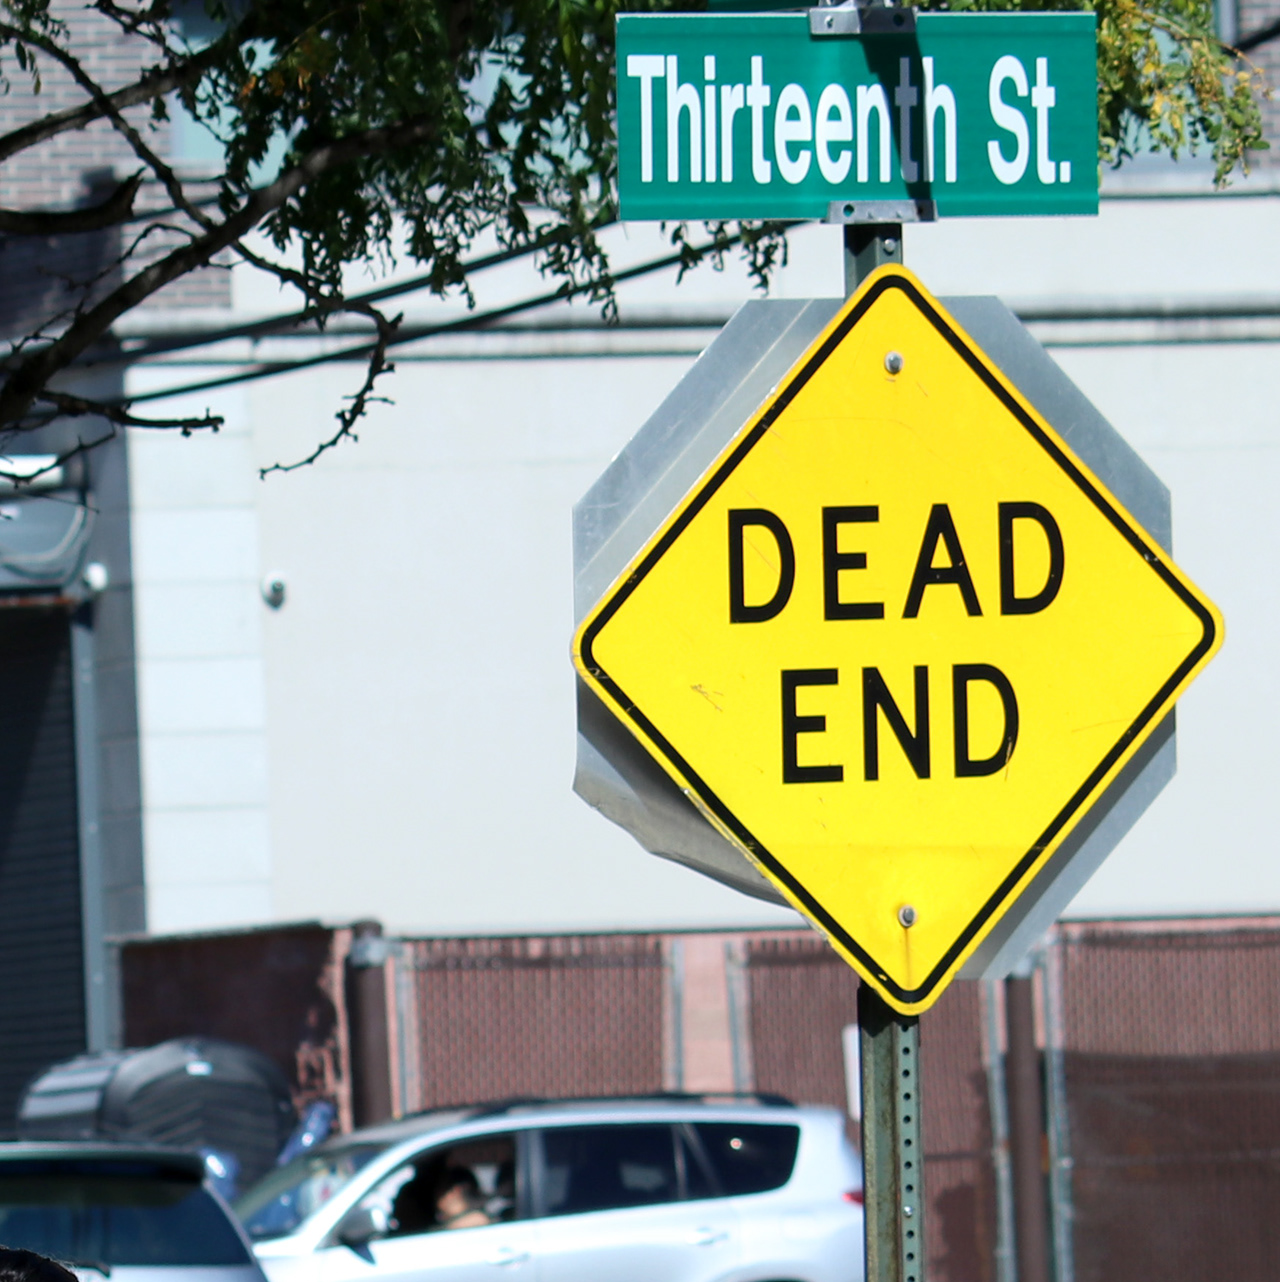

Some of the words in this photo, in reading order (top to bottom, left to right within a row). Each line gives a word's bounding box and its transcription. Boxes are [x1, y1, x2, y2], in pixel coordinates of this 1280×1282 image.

[626, 54, 957, 184] Thirteenth
[987, 55, 1071, 185] St.
[728, 501, 1065, 624] DEAD
[781, 663, 1019, 785] END
